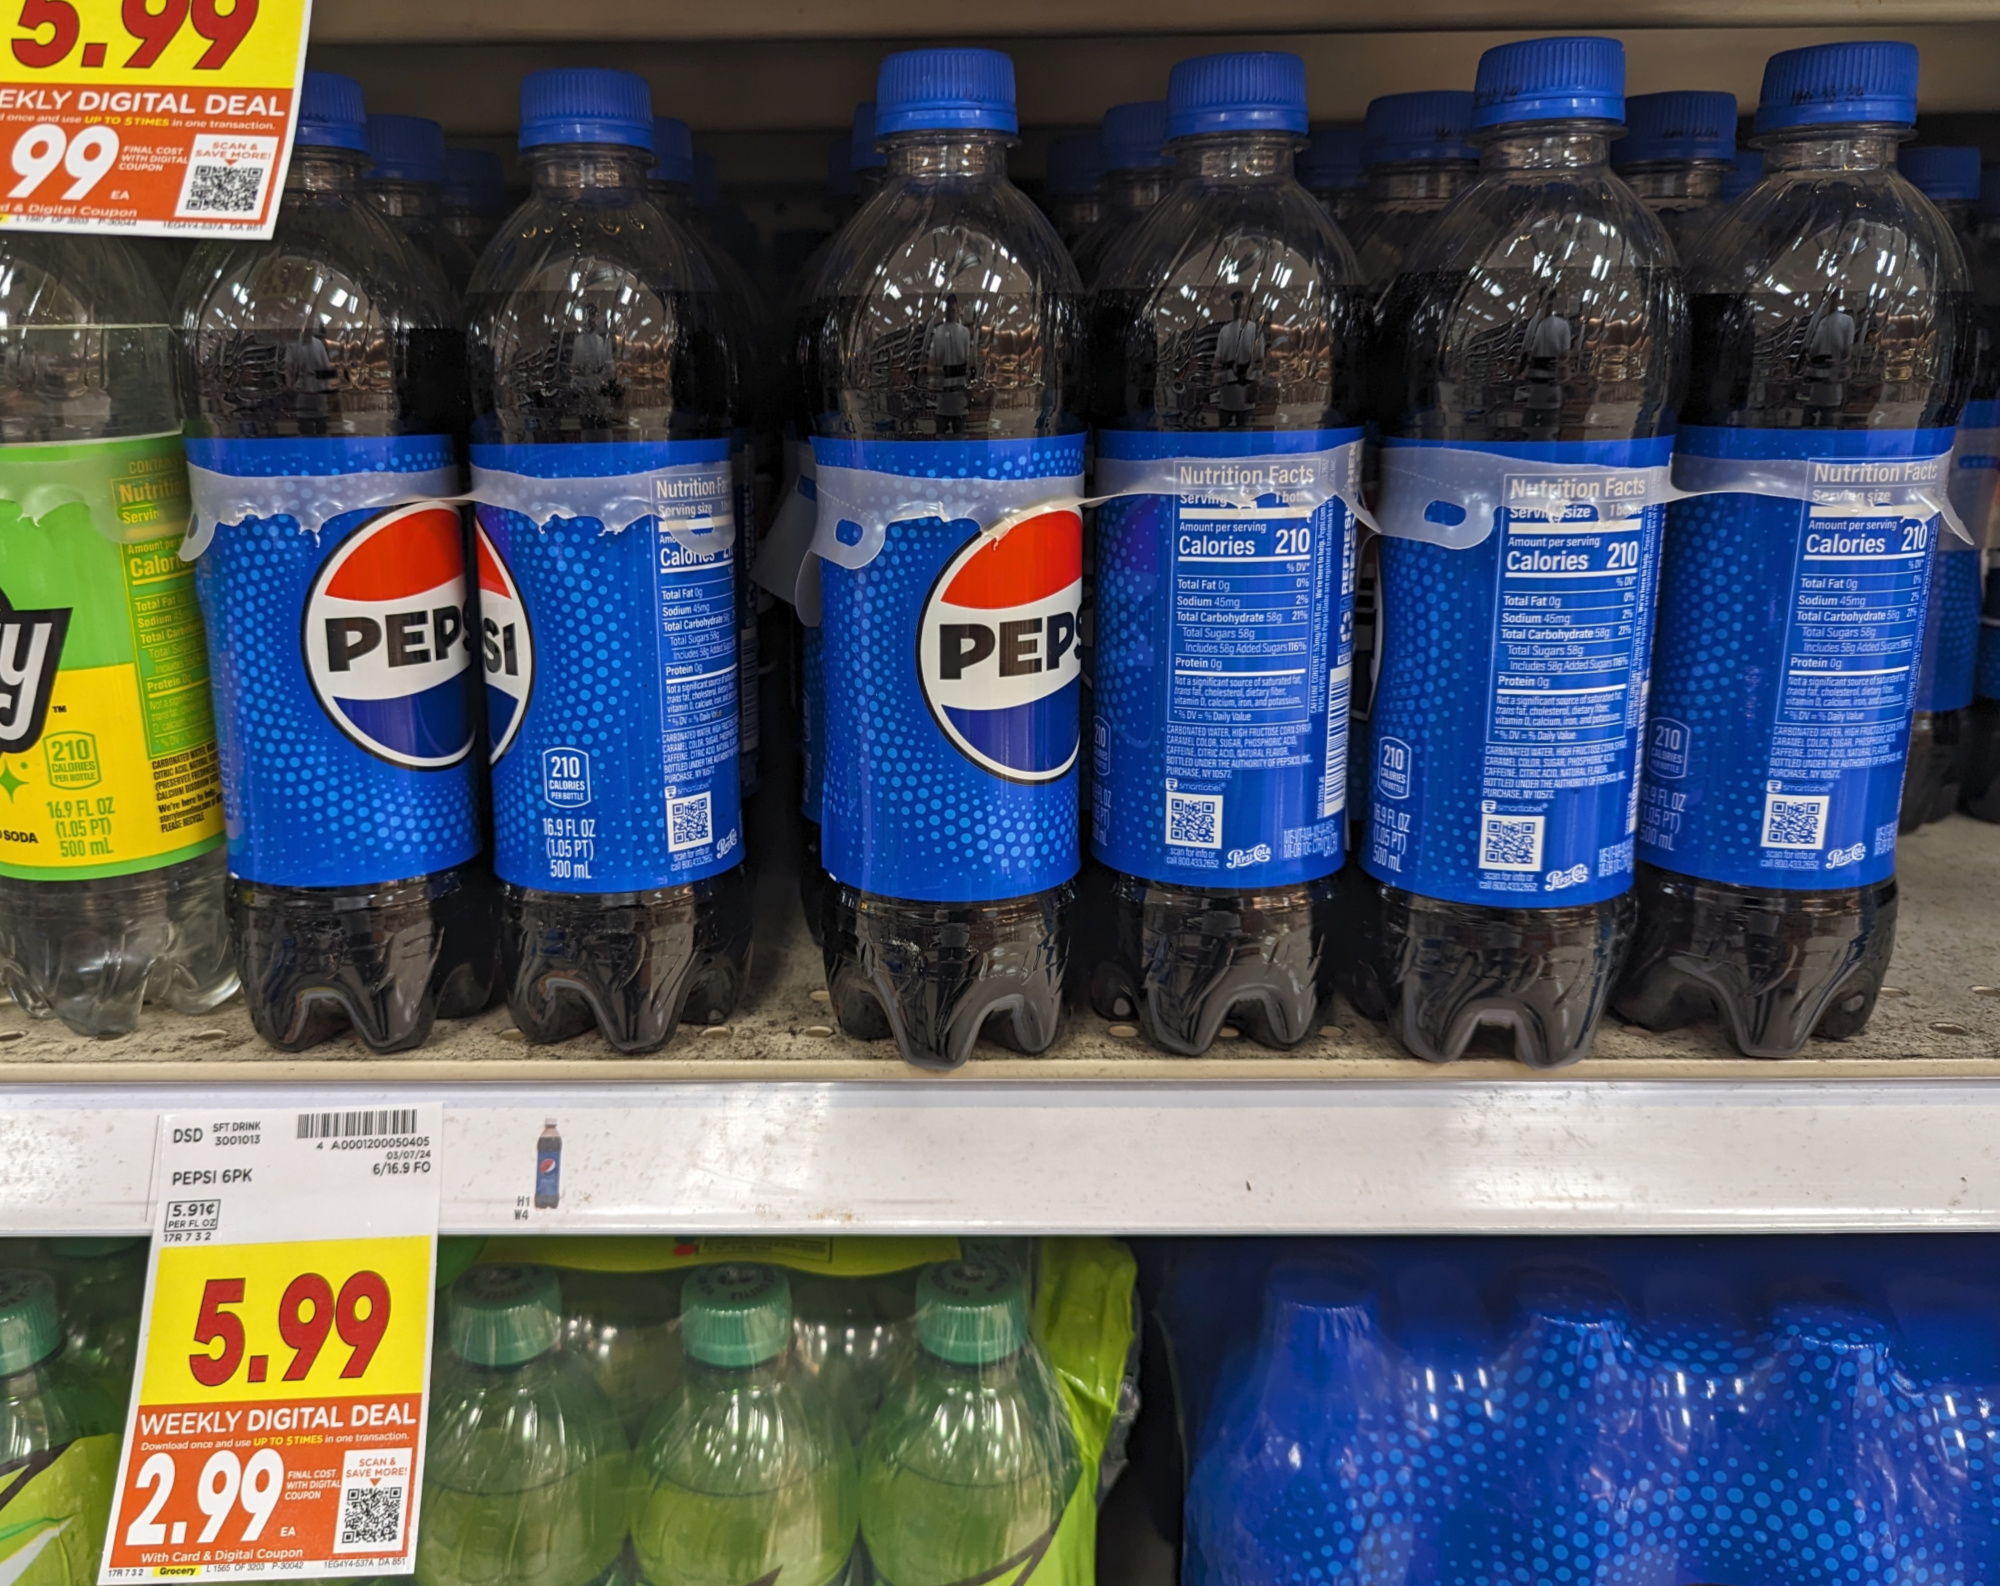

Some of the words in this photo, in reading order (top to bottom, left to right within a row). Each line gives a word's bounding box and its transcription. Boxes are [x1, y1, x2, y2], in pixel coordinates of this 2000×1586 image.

[11, 0, 259, 70] 5.99
[78, 91, 196, 114] DIGITAL
[205, 94, 285, 117] DEAL
[7, 114, 35, 122] once
[38, 114, 60, 123] and
[62, 116, 82, 124] use
[84, 115, 102, 124] UP
[104, 116, 121, 125] TO
[172, 119, 182, 127] in
[185, 120, 207, 128] one
[210, 120, 276, 130] transaction.
[123, 145, 153, 154] FINAL
[156, 146, 184, 155] COST
[212, 142, 246, 150] SCAN
[250, 143, 258, 151] &
[121, 154, 148, 163] WITH
[150, 155, 188, 164] DIGITAL
[195, 149, 227, 158] SAVE
[231, 150, 271, 160] MORE!
[118, 163, 163, 172] COUPON
[110, 190, 130, 200] EA
[13, 203, 23, 213] &
[28, 203, 77, 216] Digital
[80, 205, 137, 218] Coupon
[1180, 465, 1263, 486] Nutrition
[1268, 464, 1315, 485] Facts
[1813, 463, 1900, 483] Nutrition
[1903, 463, 1938, 482] Facts
[656, 476, 715, 499] Nutrition
[1510, 478, 1600, 499] Nutrition
[1604, 477, 1646, 498] Facts
[1179, 521, 1213, 533] Amount
[1215, 524, 1231, 536] per
[1232, 522, 1267, 535] serving
[1178, 535, 1256, 556] Calories
[1274, 527, 1311, 555] 210
[1507, 536, 1547, 548] Amount
[1548, 538, 1565, 550] per
[1566, 536, 1601, 549] serving
[1805, 533, 1886, 554] Calories
[1900, 525, 1928, 552] 210
[1506, 550, 1589, 571] Calories
[1606, 540, 1639, 569] 210
[1177, 579, 1198, 590] Total
[1200, 579, 1216, 590] Fat
[1217, 580, 1230, 593] 0g
[1176, 595, 1212, 607] Sodium
[1213, 596, 1241, 610] 45mg
[1177, 611, 1198, 623] Total
[1199, 611, 1265, 624] Carbohydrate
[1265, 612, 1283, 625] 58g
[1175, 656, 1209, 668] Protein
[1209, 657, 1223, 671] 0g
[51, 739, 90, 762] 210
[51, 761, 96, 773] CALORIES
[551, 756, 580, 778] 210
[54, 774, 69, 782] PER
[70, 772, 97, 782] BOTTLE
[549, 780, 585, 791] CALORIES
[551, 792, 563, 800] PER
[563, 792, 585, 801] BOTTLE
[46, 800, 73, 819] 16.9
[76, 799, 94, 817] FL
[97, 796, 116, 815] OZ
[55, 819, 87, 839] (1.05
[90, 817, 112, 836] PT)
[542, 818, 564, 837] 16.9
[566, 819, 579, 837] FL
[581, 819, 596, 838] OZ
[3, 829, 39, 844] SODA
[60, 840, 86, 858] 500
[90, 837, 114, 855] mL
[546, 839, 572, 859] (1.05
[575, 839, 594, 860] PT)
[550, 860, 571, 878] 500
[574, 862, 592, 879] mL
[213, 1122, 230, 1132] SFT
[232, 1121, 261, 1131] DRINK
[173, 1127, 204, 1143] DSD
[215, 1134, 261, 1146] 3001013
[316, 1141, 324, 1150] 4
[331, 1136, 430, 1150] A0001200050405
[386, 1149, 431, 1160] 03/07/24
[373, 1161, 410, 1176] 6/16.9
[414, 1160, 432, 1173] FO
[172, 1169, 217, 1186] PEPSI
[222, 1168, 253, 1183] 6PK
[517, 1195, 530, 1207] H1
[172, 1203, 216, 1217] 5.91¢
[514, 1209, 529, 1220] W4
[168, 1219, 186, 1229] PER
[188, 1219, 199, 1228] FL
[202, 1218, 216, 1227] OZ
[163, 1233, 183, 1242] 17R
[185, 1232, 192, 1241] 7
[195, 1232, 202, 1241] 3
[205, 1231, 212, 1240] 2
[189, 1270, 392, 1387] 5.99
[140, 1410, 242, 1436] WEEKLY
[247, 1405, 344, 1432] DIGITAL
[351, 1402, 416, 1427] DEAL
[141, 1440, 189, 1451] Download
[190, 1441, 213, 1449] once
[215, 1438, 234, 1448] and
[235, 1439, 251, 1447] use
[253, 1437, 267, 1446] UP
[270, 1436, 284, 1446] TO
[325, 1435, 333, 1443] in
[355, 1432, 409, 1442] transaction.
[359, 1458, 387, 1467] SCAN
[389, 1457, 396, 1466] &
[288, 1470, 311, 1479] FINAL
[313, 1469, 336, 1478] COST
[345, 1469, 371, 1478] SAVE
[374, 1467, 408, 1477] MORE!
[286, 1481, 309, 1490] WITH
[310, 1479, 342, 1489] DIGITAL
[125, 1448, 284, 1546] 2.99
[285, 1491, 321, 1500] COUPON
[280, 1526, 296, 1537] EA
[141, 1552, 169, 1563] With
[172, 1551, 201, 1562] Card
[203, 1551, 212, 1561] &
[214, 1549, 254, 1563] Digital
[257, 1548, 303, 1560] Coupon
[378, 1558, 390, 1567] DA
[108, 1569, 122, 1577] 17R
[138, 1568, 144, 1576] 2
[159, 1567, 196, 1576] Grocery
[234, 1563, 245, 1571] OF
